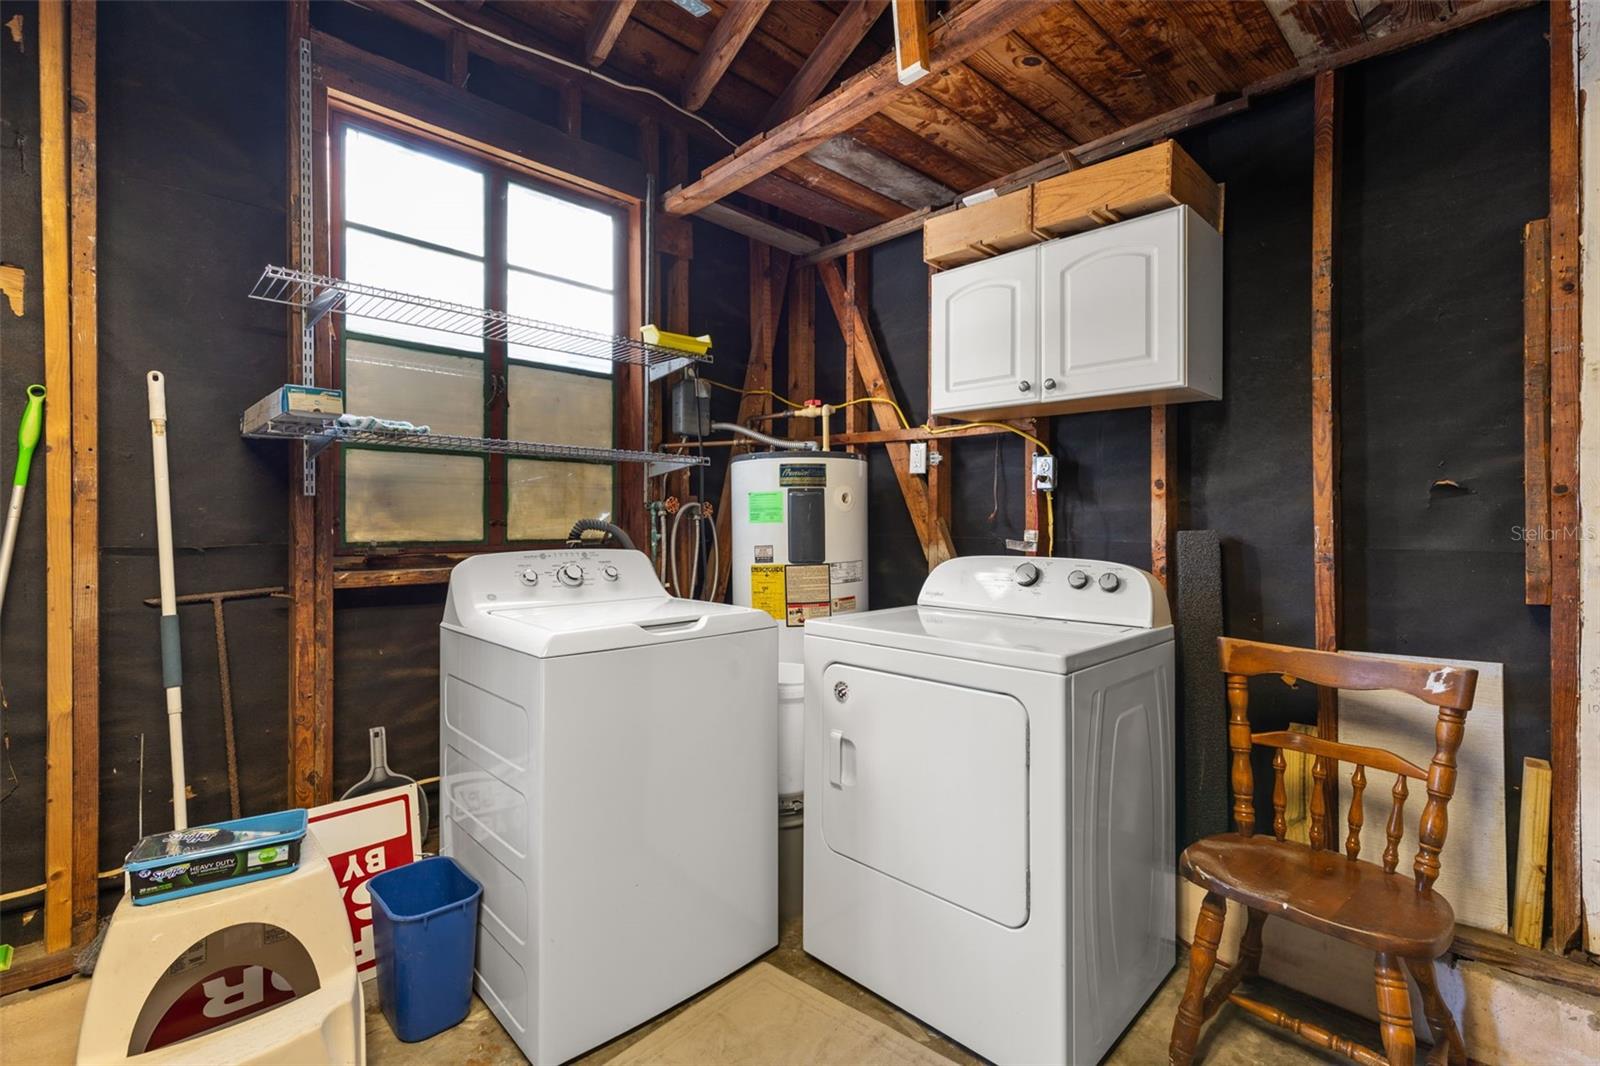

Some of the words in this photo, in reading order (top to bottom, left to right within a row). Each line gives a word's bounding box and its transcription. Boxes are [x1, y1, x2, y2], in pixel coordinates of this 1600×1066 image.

[162, 831, 218, 843] Swiffer
[189, 861, 215, 872] HEAVY
[215, 858, 236, 869] DUTY
[342, 845, 386, 882] BY
[150, 865, 188, 882] Swiffer
